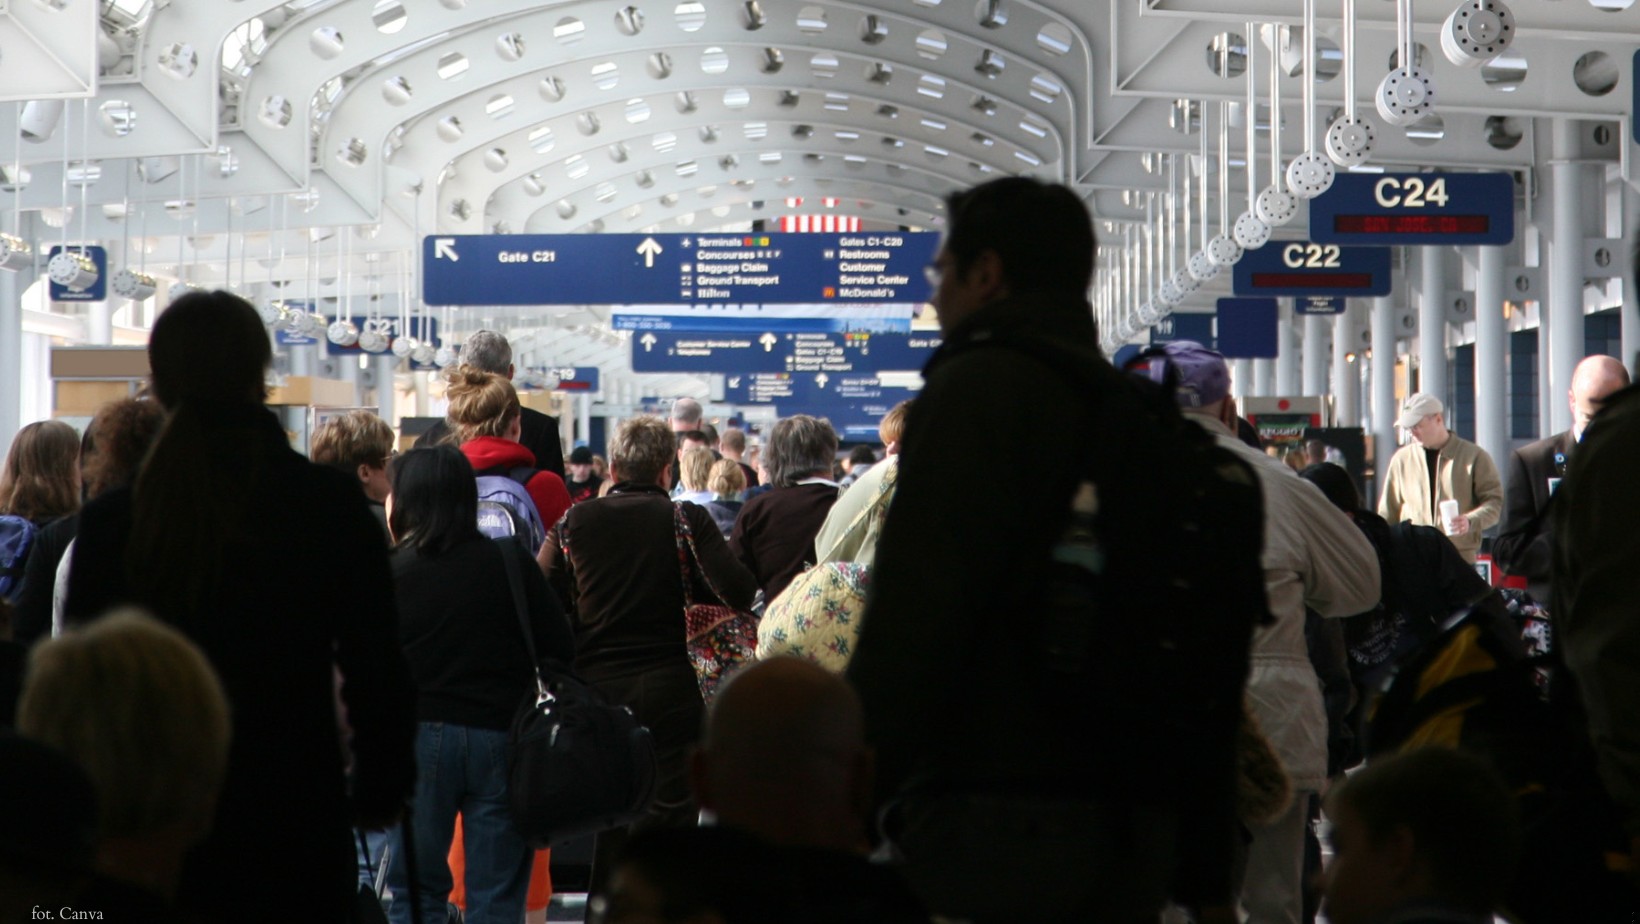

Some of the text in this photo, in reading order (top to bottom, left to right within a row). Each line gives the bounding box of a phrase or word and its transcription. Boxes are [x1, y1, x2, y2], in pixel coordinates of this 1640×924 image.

[1375, 177, 1448, 208] C24
[697, 238, 742, 248] Terminals
[839, 237, 902, 247] Gates C1-C20
[498, 251, 556, 263] Gate C21
[697, 250, 755, 260] Concourses
[839, 249, 890, 260] Restrooms
[1283, 244, 1341, 268] C22
[697, 263, 768, 275] Baggage Claim
[839, 262, 886, 273] Customer
[697, 275, 779, 287] Ground Transport
[839, 275, 909, 285] Service Center
[697, 288, 731, 298] Hilton
[839, 287, 895, 298] McDonald's
[908, 339, 928, 348] Gate
